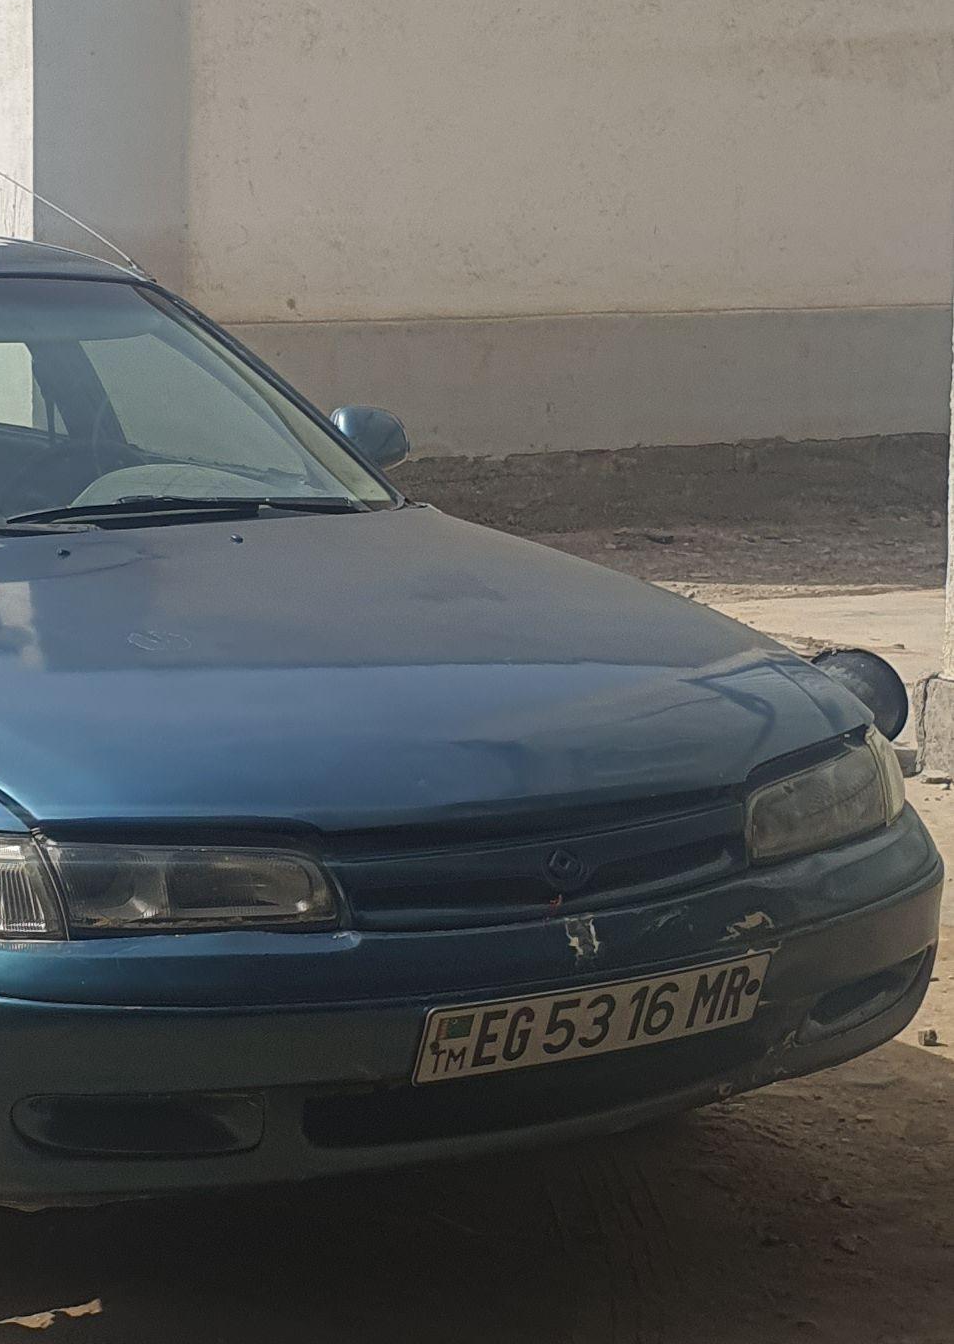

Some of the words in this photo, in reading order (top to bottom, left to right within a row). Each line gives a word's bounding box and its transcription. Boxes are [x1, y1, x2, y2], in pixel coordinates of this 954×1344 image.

[471, 1007, 535, 1067] EG
[686, 966, 751, 1028] MR
[430, 1046, 467, 1074] TM
